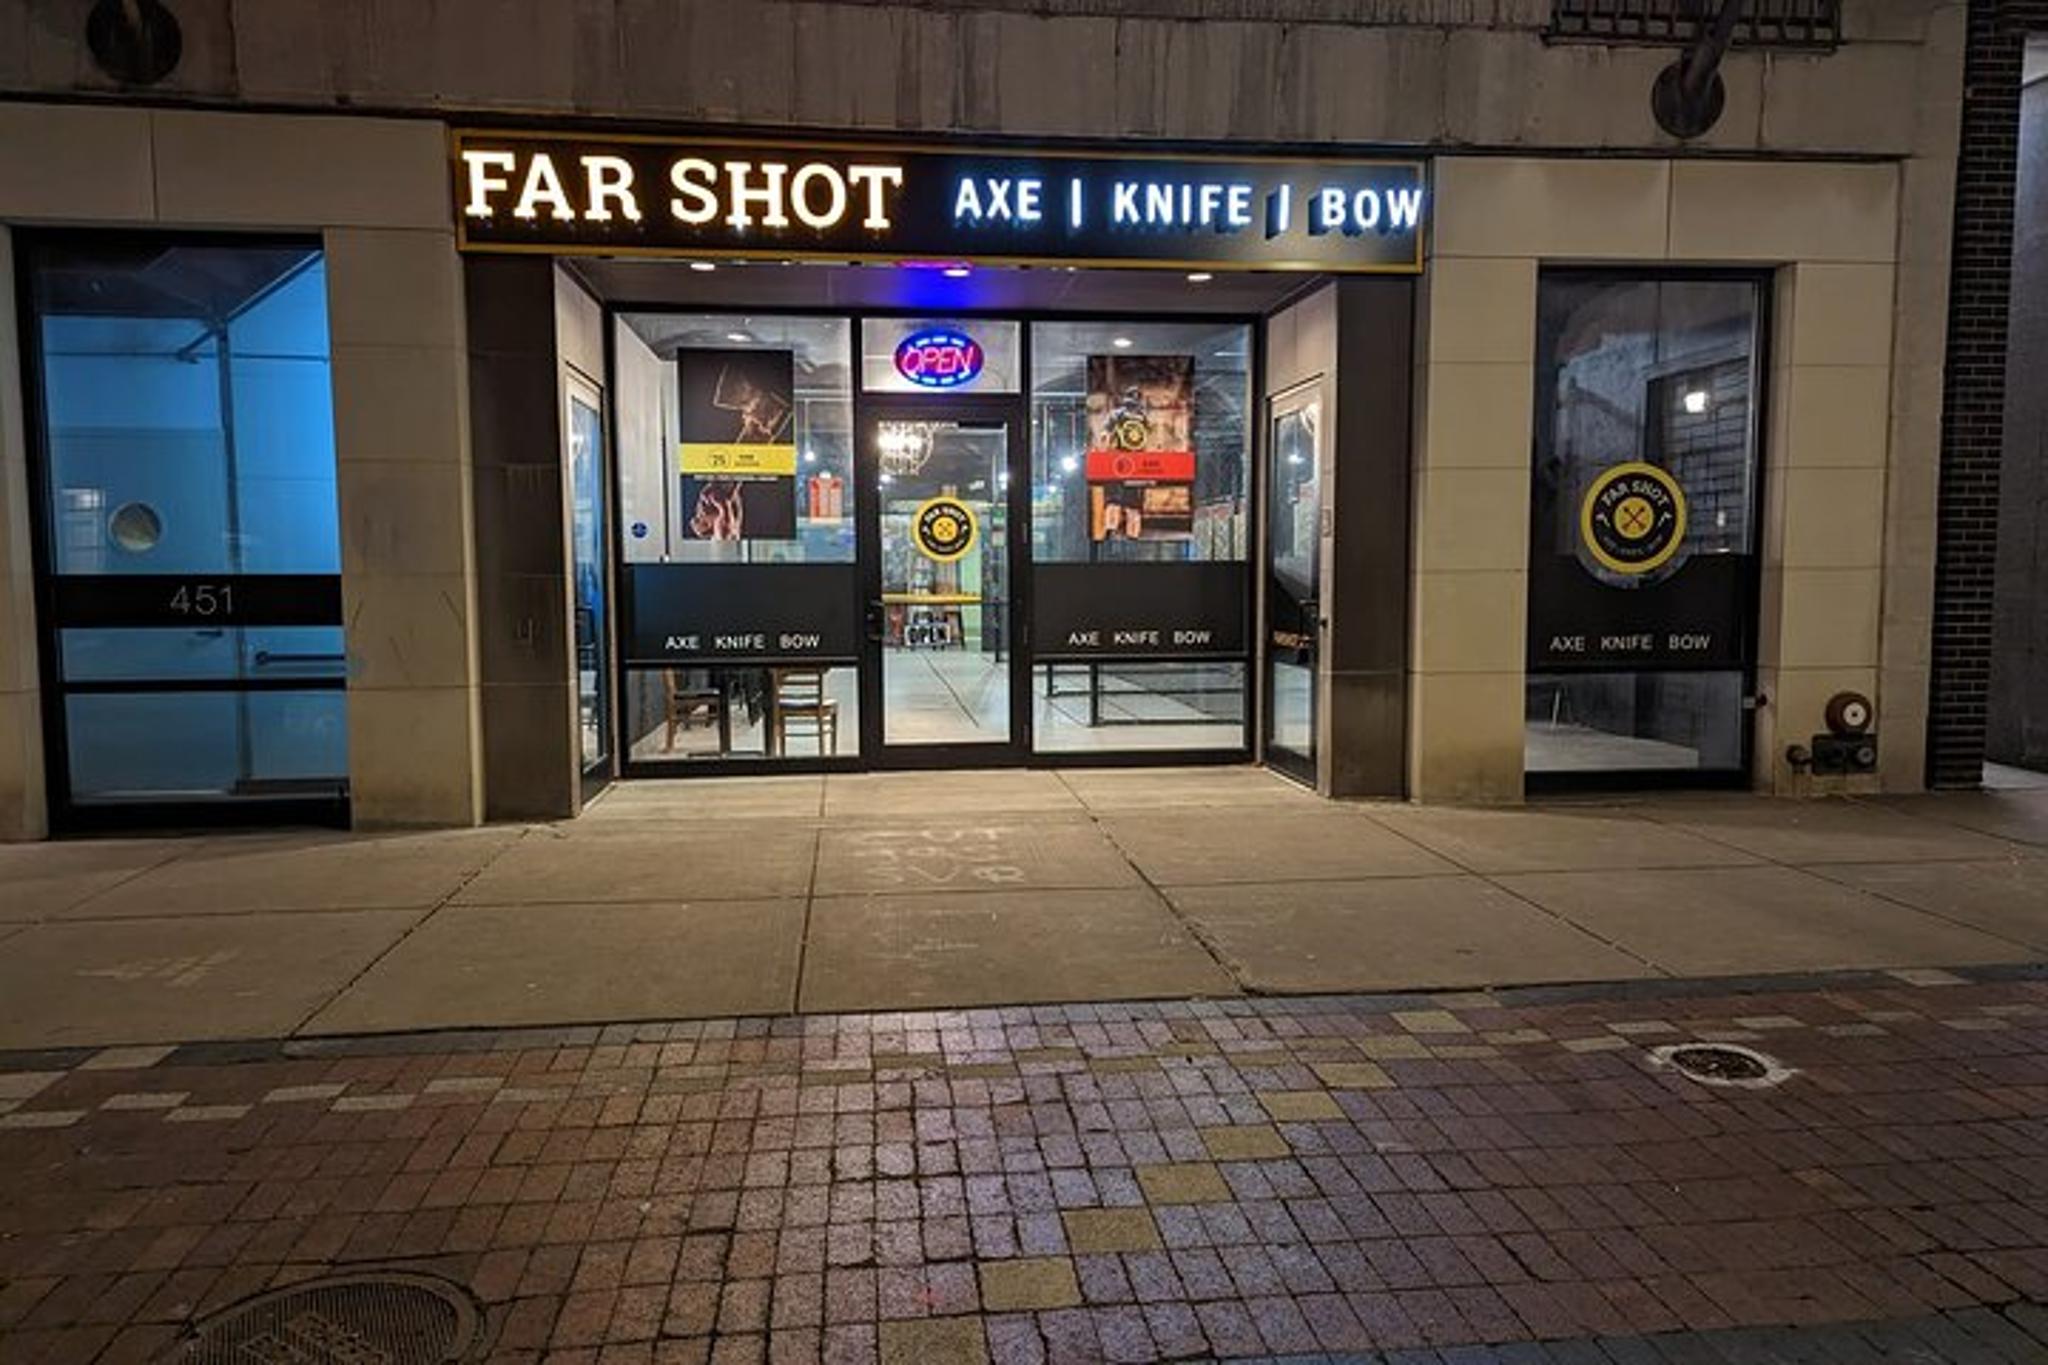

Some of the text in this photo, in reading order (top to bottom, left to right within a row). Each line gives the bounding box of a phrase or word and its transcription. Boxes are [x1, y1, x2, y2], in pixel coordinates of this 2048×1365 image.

[463, 150, 903, 229] FAR SHOT
[955, 178, 1042, 221] AXE
[1114, 182, 1252, 225] KNIFE
[1320, 188, 1423, 228] BOW
[902, 346, 974, 375] OPEN
[1601, 480, 1669, 507] FAR SHOT
[169, 584, 232, 615] 451
[665, 633, 820, 649] AXE KNIFE BOW
[1067, 630, 1212, 646] AXE KNIFE BOW
[1549, 633, 1711, 651] AXE KNIFE BOW
